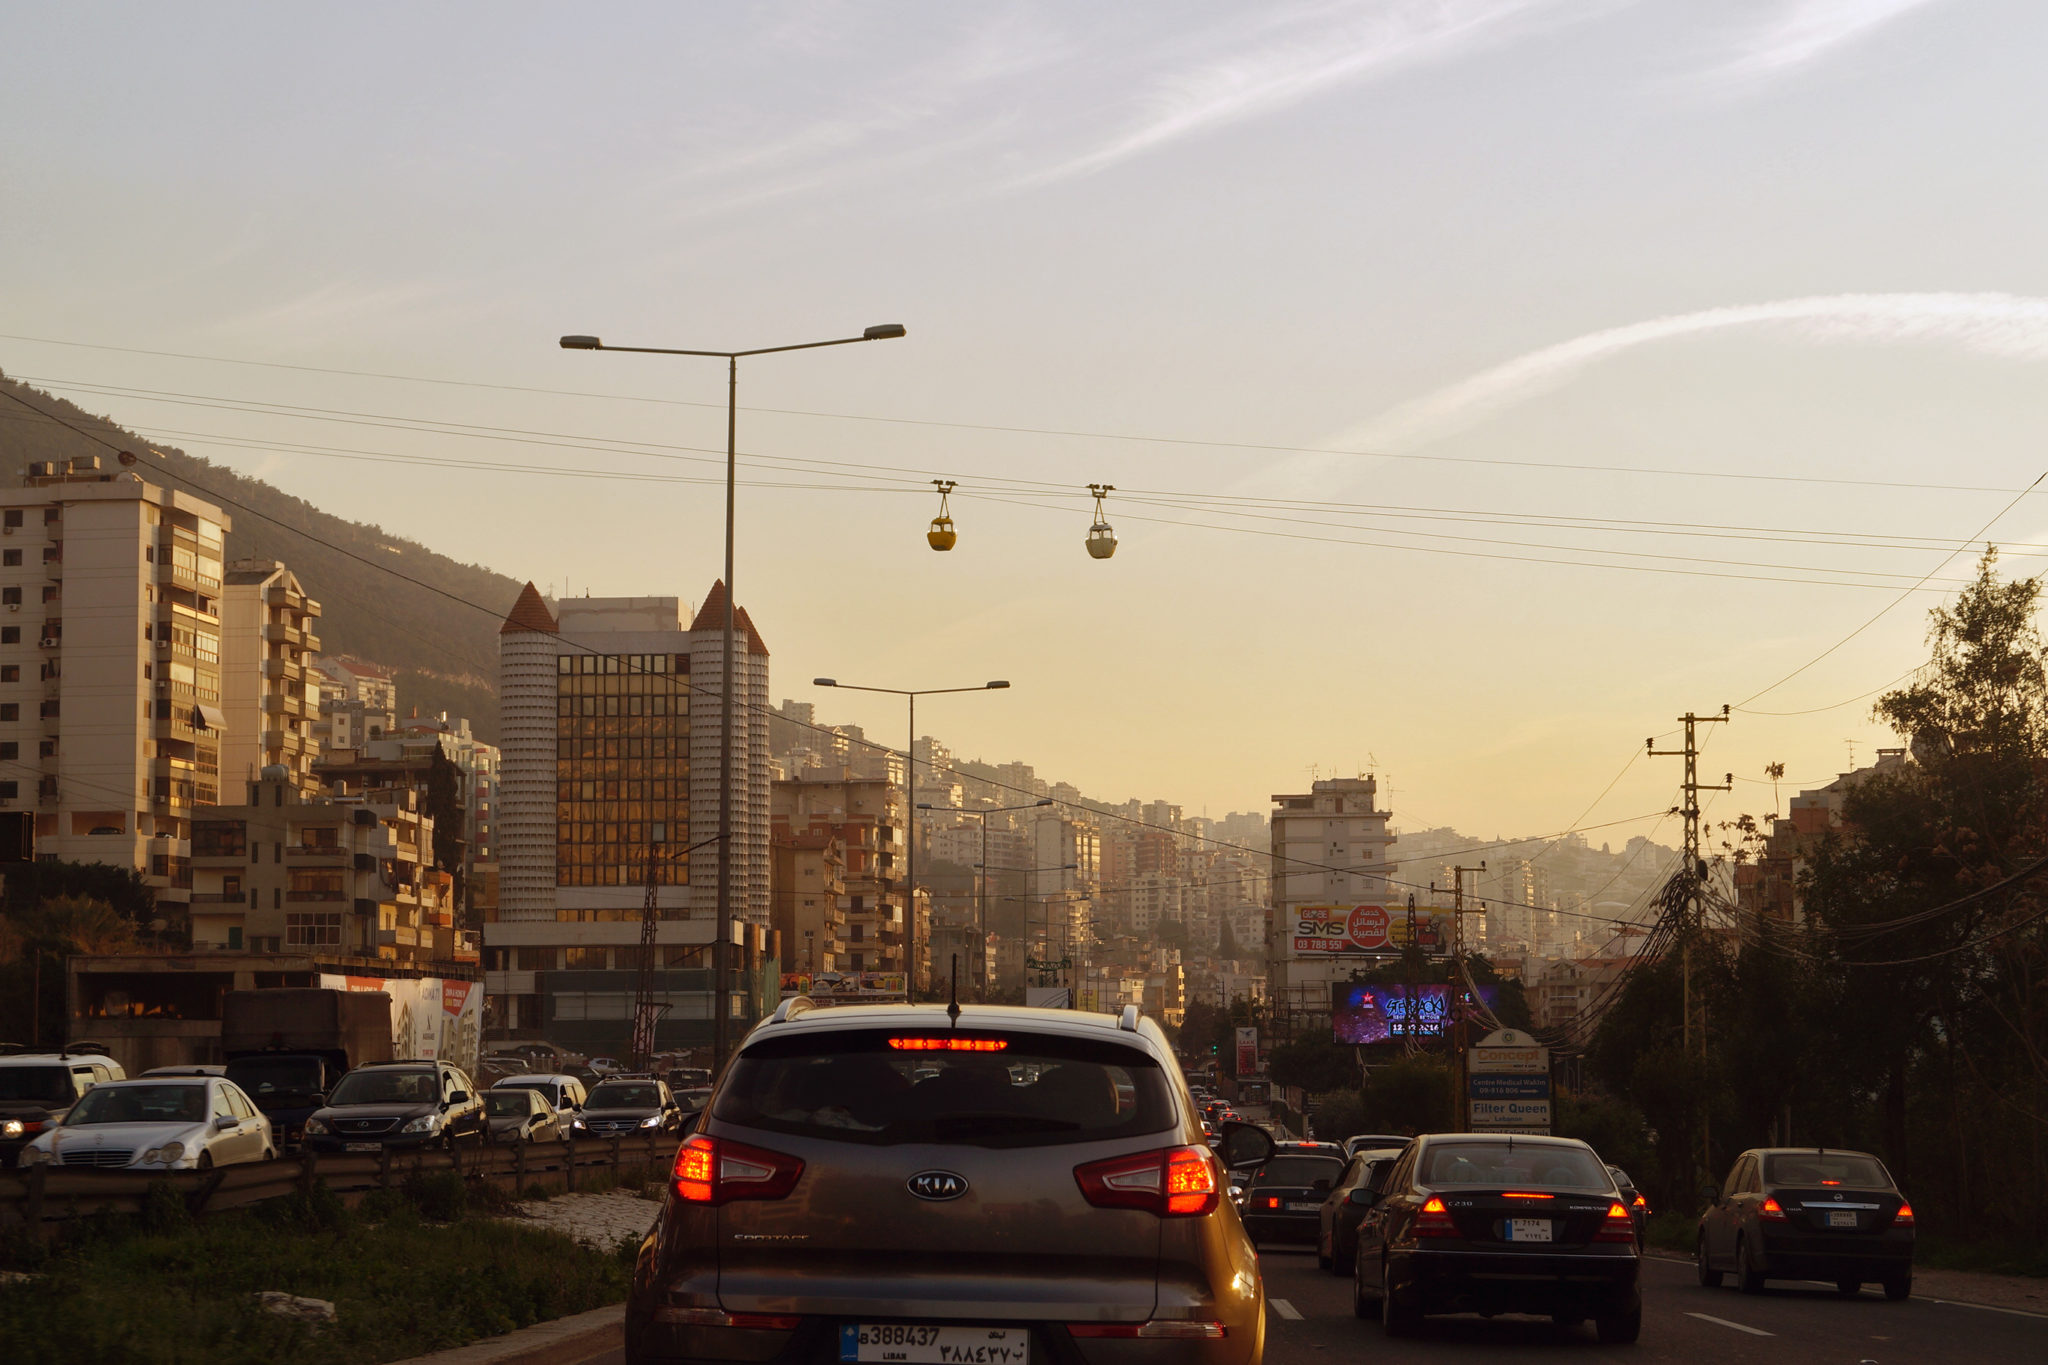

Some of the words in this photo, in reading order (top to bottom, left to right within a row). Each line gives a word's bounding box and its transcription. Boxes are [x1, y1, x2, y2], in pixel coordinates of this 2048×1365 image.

[1360, 908, 1380, 916] خدمة
[1352, 917, 1385, 927] الرسائل
[1298, 921, 1345, 935] SMS
[1353, 928, 1385, 938] القصيرة
[1297, 940, 1308, 949] 03
[1311, 940, 1327, 949] 788
[1328, 941, 1342, 950] 551
[1478, 1049, 1540, 1065] Concept
[1473, 1103, 1505, 1113] Filter
[1509, 1103, 1547, 1114] Queen
[917, 1177, 956, 1193] KIA
[883, 1352, 907, 1361] LIBAN
